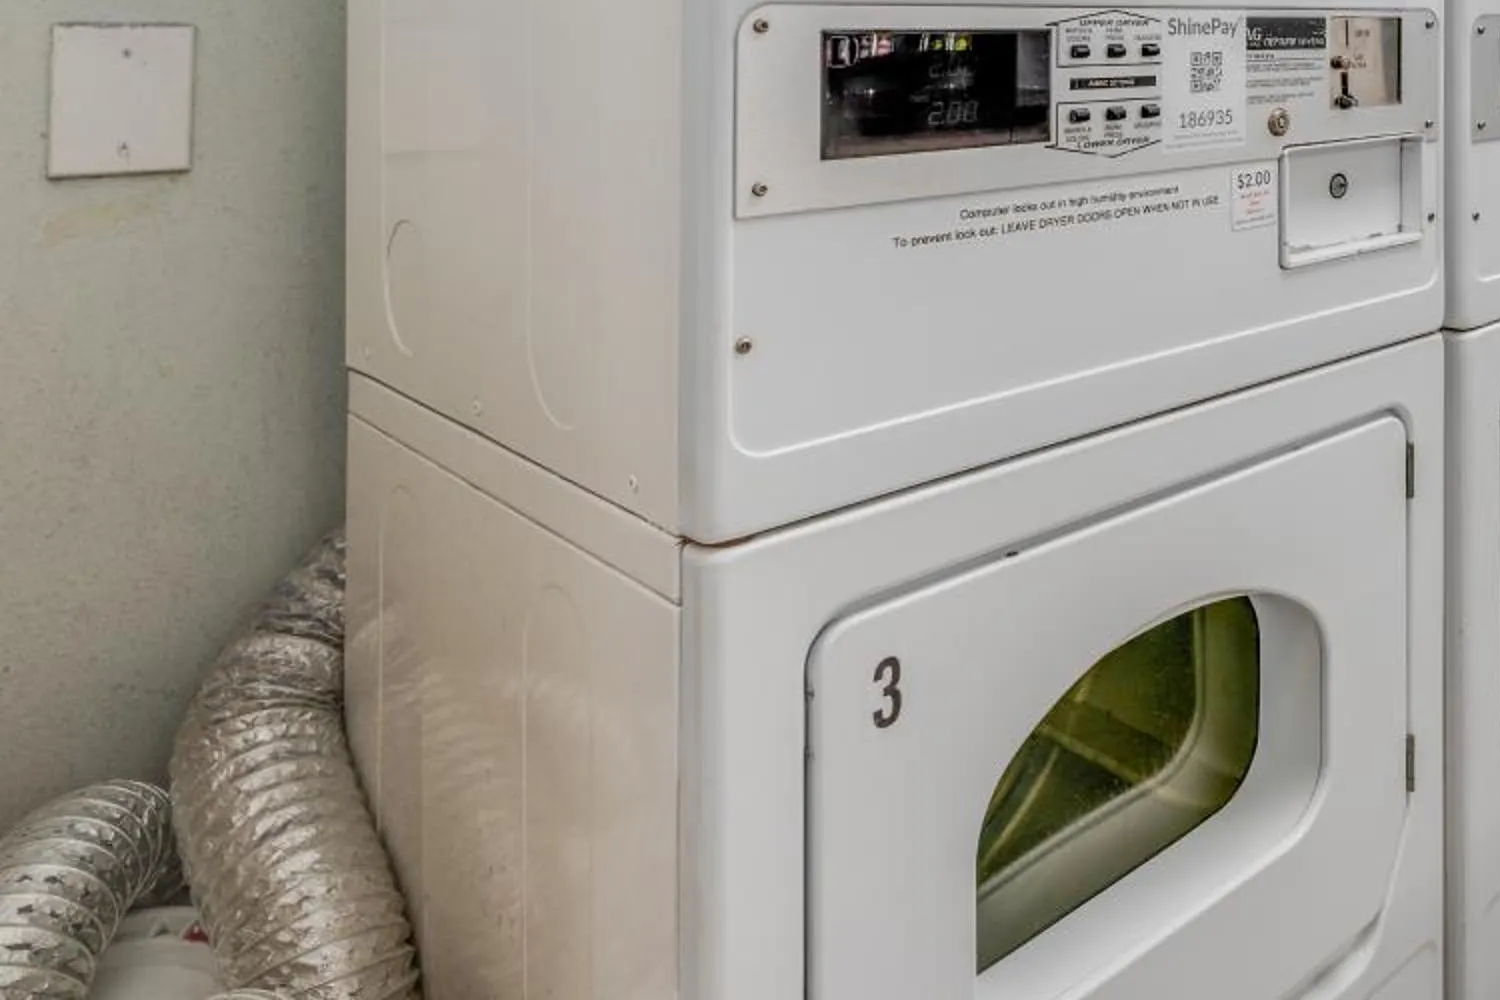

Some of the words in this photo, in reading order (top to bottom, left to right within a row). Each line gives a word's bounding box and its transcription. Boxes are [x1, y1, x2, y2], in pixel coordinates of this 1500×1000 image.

[1167, 16, 1238, 38] ShinePay
[1179, 108, 1233, 129] 186935
[1237, 169, 1271, 190] $2.00
[893, 236, 907, 248] To
[1001, 219, 1037, 235] LEAVE
[1039, 213, 1075, 229] DRYER
[1077, 209, 1112, 224] DOORS
[1114, 205, 1141, 219] OPEN
[873, 656, 902, 728] 3
